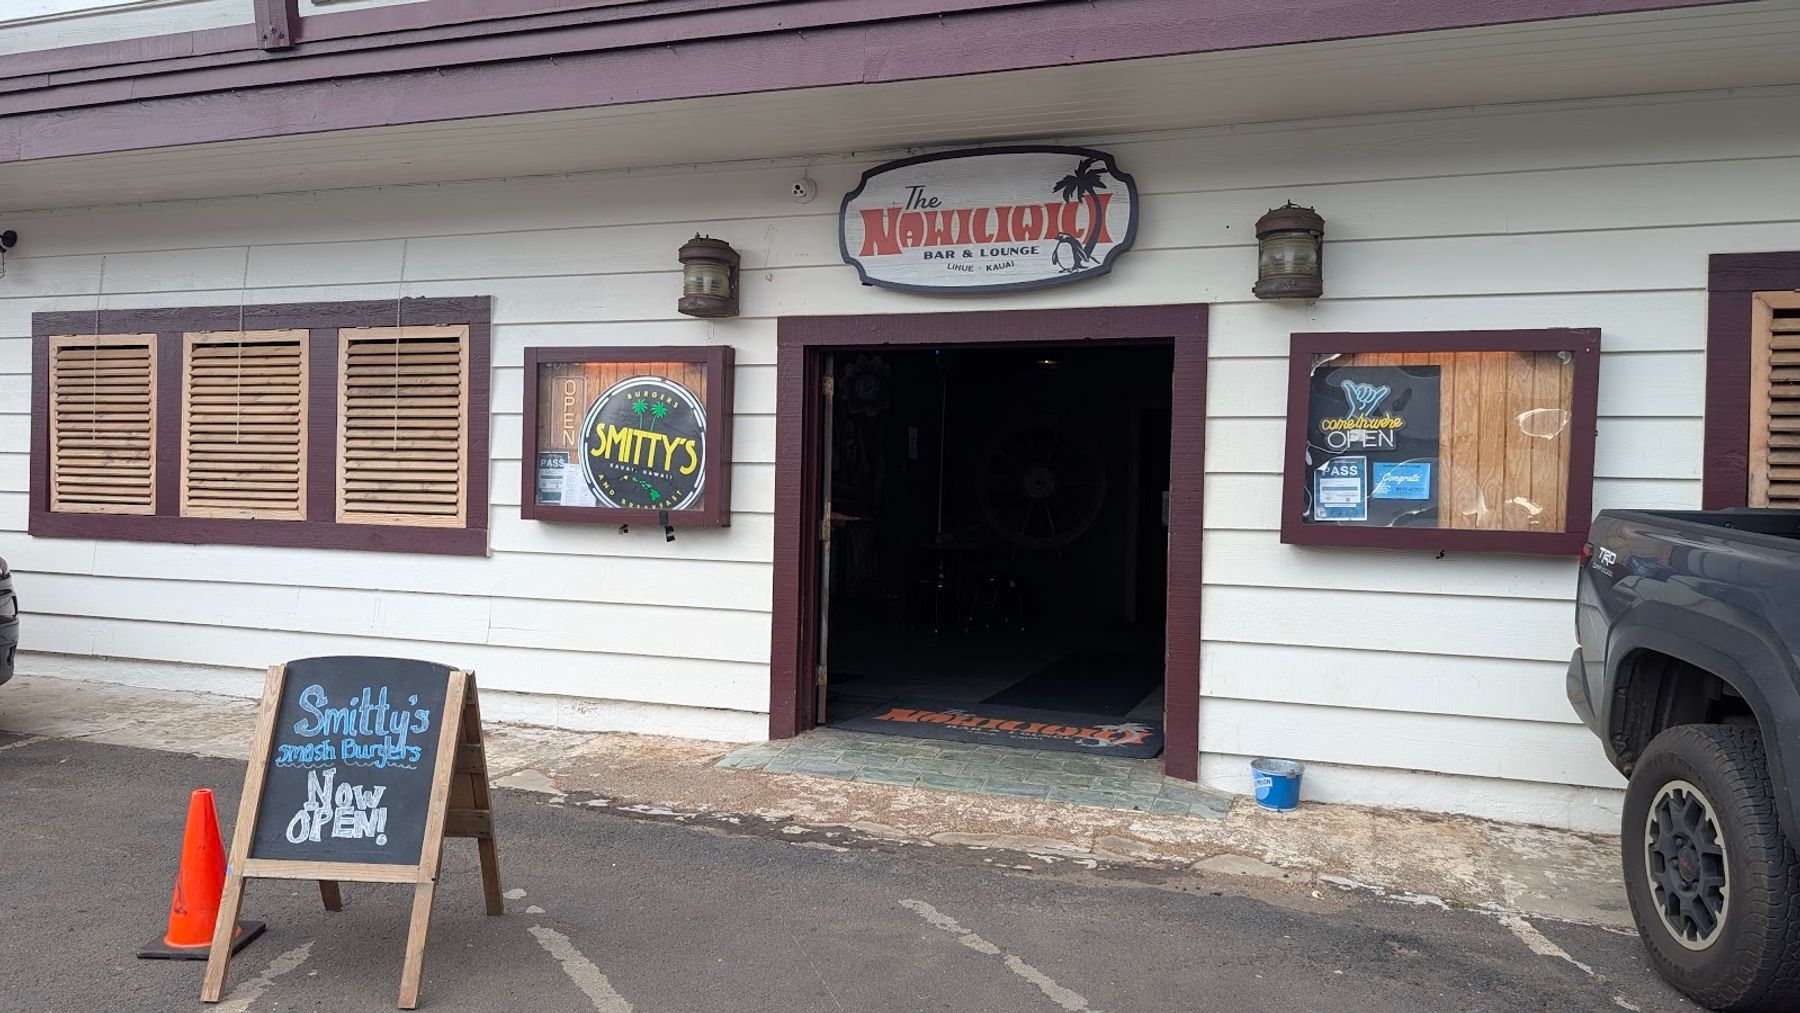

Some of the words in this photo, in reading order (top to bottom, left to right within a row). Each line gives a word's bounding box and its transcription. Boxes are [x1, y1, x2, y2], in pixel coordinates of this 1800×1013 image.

[905, 185, 942, 210] The
[923, 250, 956, 260] BAR
[962, 249, 973, 258] &
[980, 245, 1040, 257] LOUNGE
[947, 262, 974, 272] LIHUE
[986, 260, 1015, 272] KAUAI
[627, 390, 679, 409] BURGERS
[562, 380, 577, 446] OPEN
[1327, 429, 1394, 448] OPEN
[590, 423, 698, 475] SMITTY'S
[540, 458, 565, 468] PASS
[1322, 465, 1358, 476] PASS
[643, 469, 673, 480] HAWAII
[598, 474, 615, 496] AND
[1599, 546, 1617, 567] TRD
[293, 684, 430, 747] Smitty's
[286, 807, 388, 846] OPEN!
